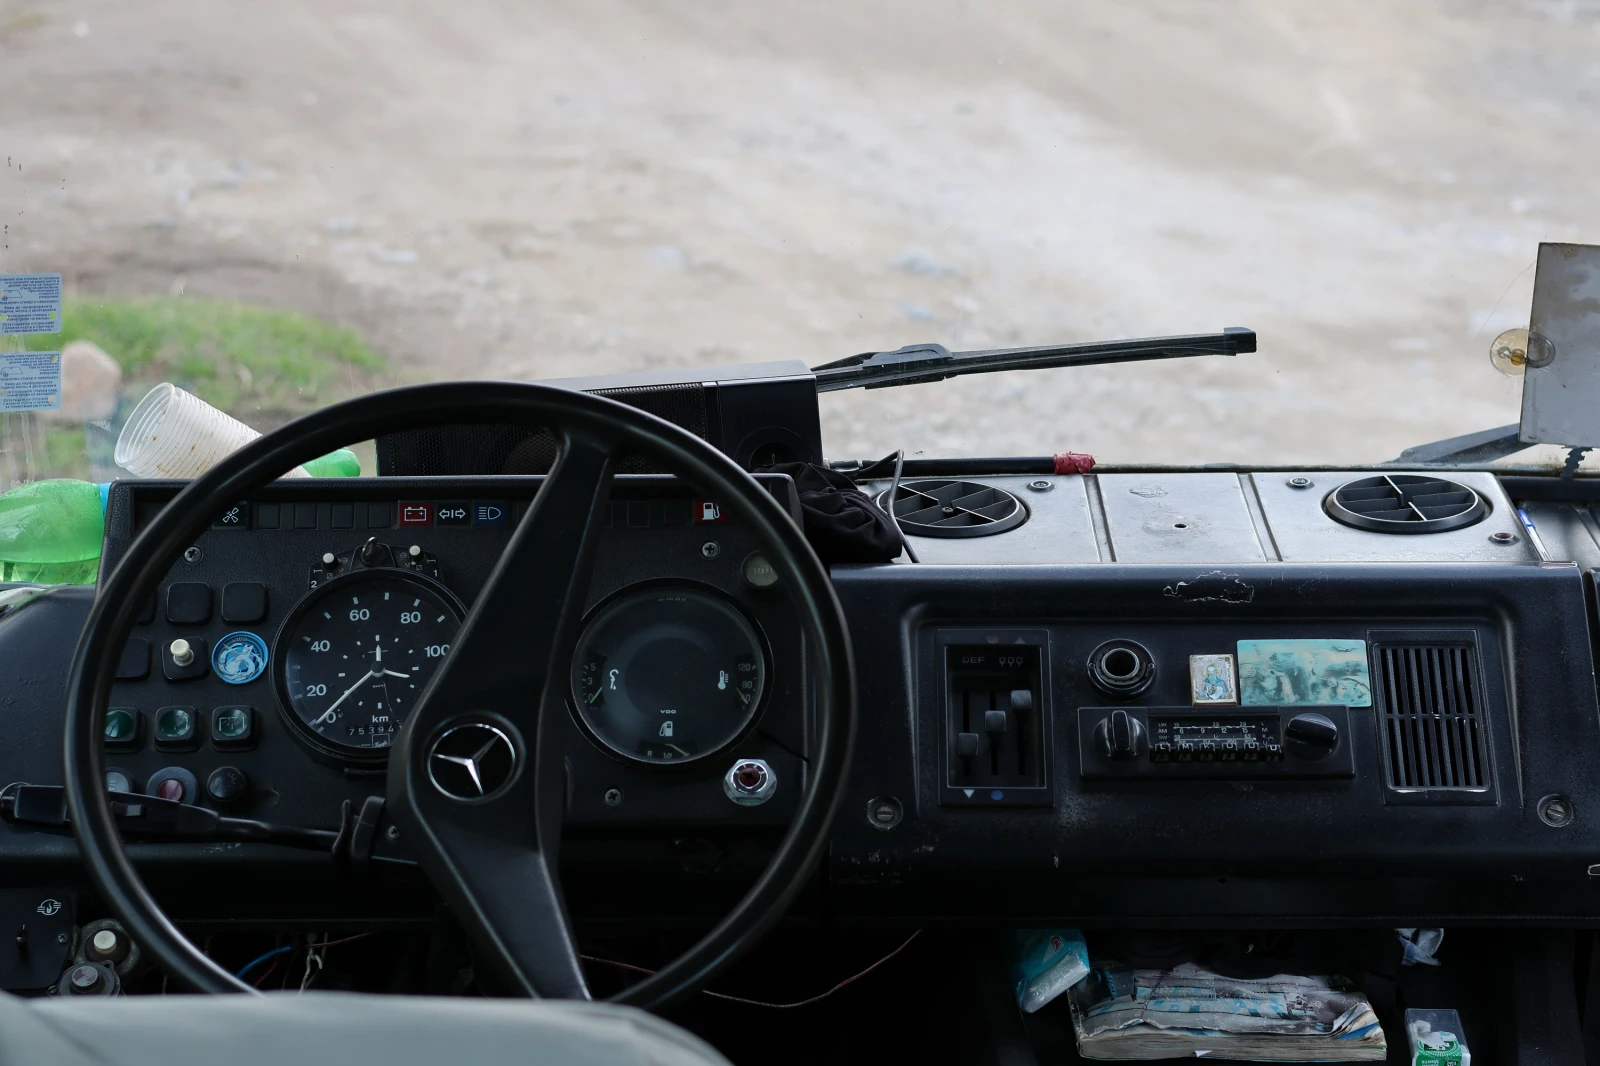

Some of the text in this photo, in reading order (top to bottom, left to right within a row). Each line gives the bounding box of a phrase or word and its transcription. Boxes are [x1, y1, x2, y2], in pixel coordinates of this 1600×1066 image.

[433, 569, 438, 577] 1
[310, 580, 318, 588] 2
[349, 608, 370, 621] 60
[400, 611, 421, 624] 80
[310, 640, 330, 652] 40
[424, 644, 450, 658] 100
[590, 662, 596, 671] 5
[587, 677, 593, 685] 3
[306, 684, 326, 697] 20
[326, 711, 336, 723] 0
[372, 715, 388, 723] km
